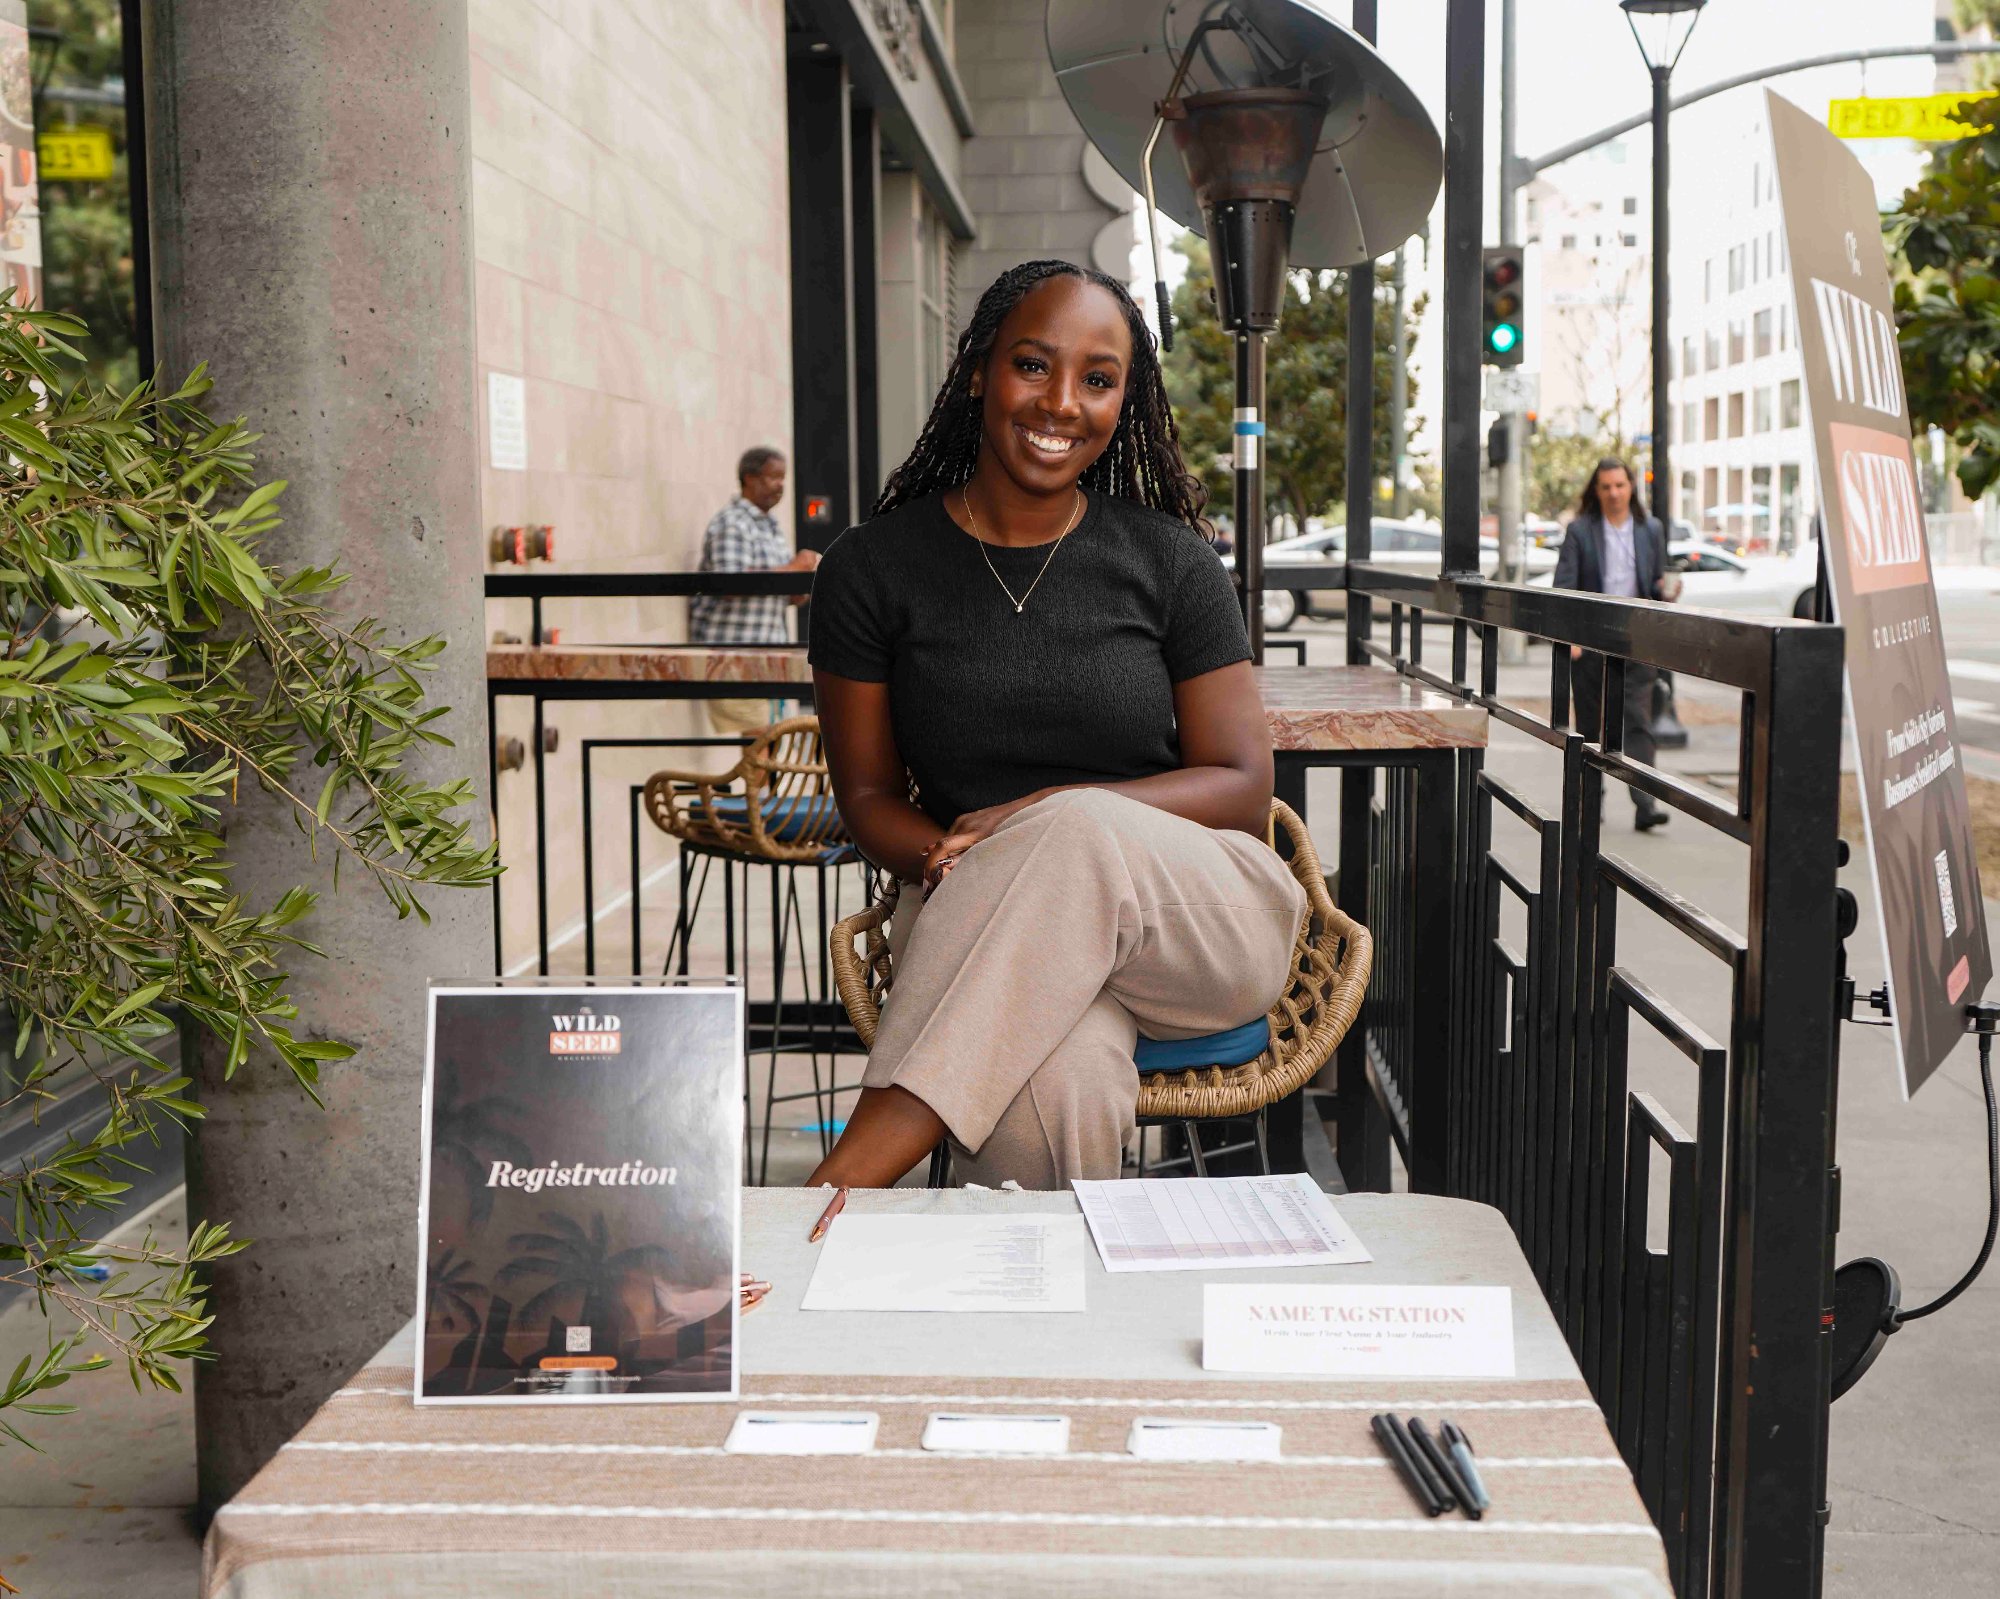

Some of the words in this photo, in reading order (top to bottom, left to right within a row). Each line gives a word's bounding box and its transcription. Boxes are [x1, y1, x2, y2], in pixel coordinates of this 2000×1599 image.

[1843, 104, 1901, 130] PED
[1841, 449, 1921, 567] SEED
[1873, 615, 1931, 649] COLLECTIVE
[552, 1015, 621, 1032] WILD
[553, 1034, 617, 1051] SEED
[485, 1160, 677, 1194] Registration
[1248, 1305, 1315, 1323] NAME
[1319, 1305, 1364, 1323] TAG
[1368, 1306, 1465, 1324] STATION
